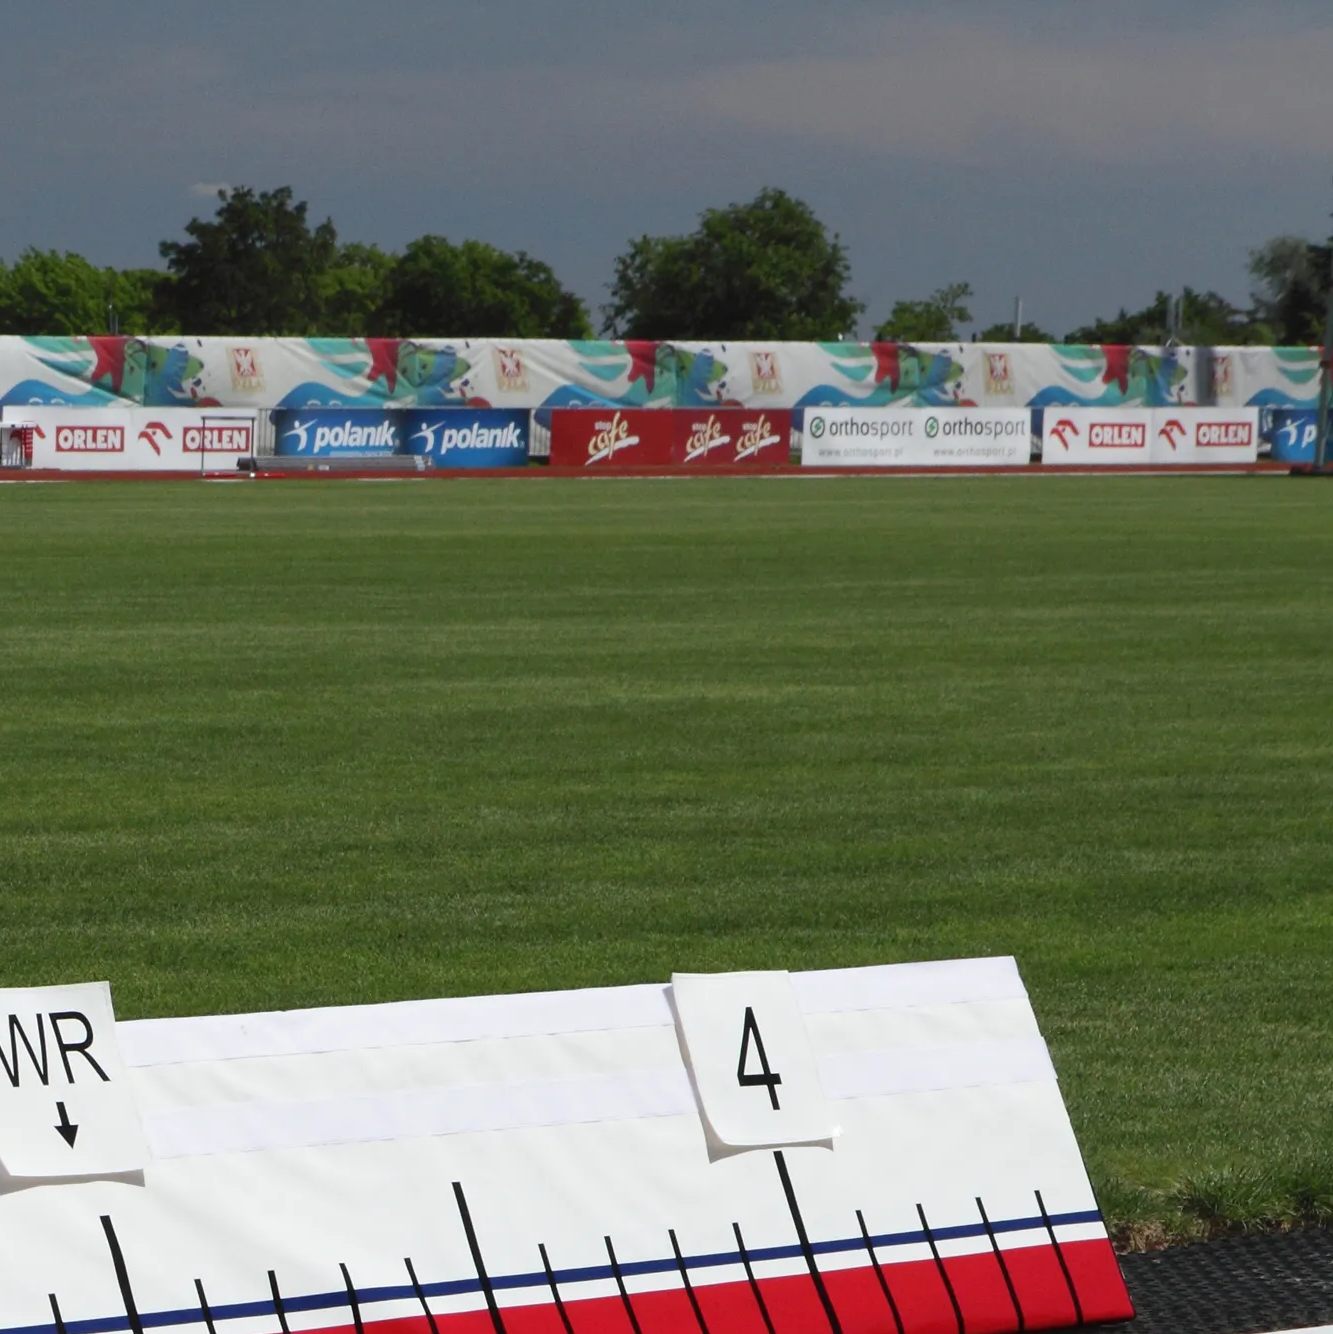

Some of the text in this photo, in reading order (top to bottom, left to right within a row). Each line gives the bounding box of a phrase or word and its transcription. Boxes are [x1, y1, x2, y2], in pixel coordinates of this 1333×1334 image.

[313, 420, 396, 451] polanik
[440, 421, 521, 454] polanik
[829, 417, 913, 439] orthosport
[942, 416, 1025, 439] orthosport
[1090, 426, 1144, 445] ORLEN
[1197, 425, 1249, 444] ORLEN
[58, 429, 122, 450] ORLEN
[185, 429, 248, 450] ORLEN
[737, 1006, 782, 1110] 4
